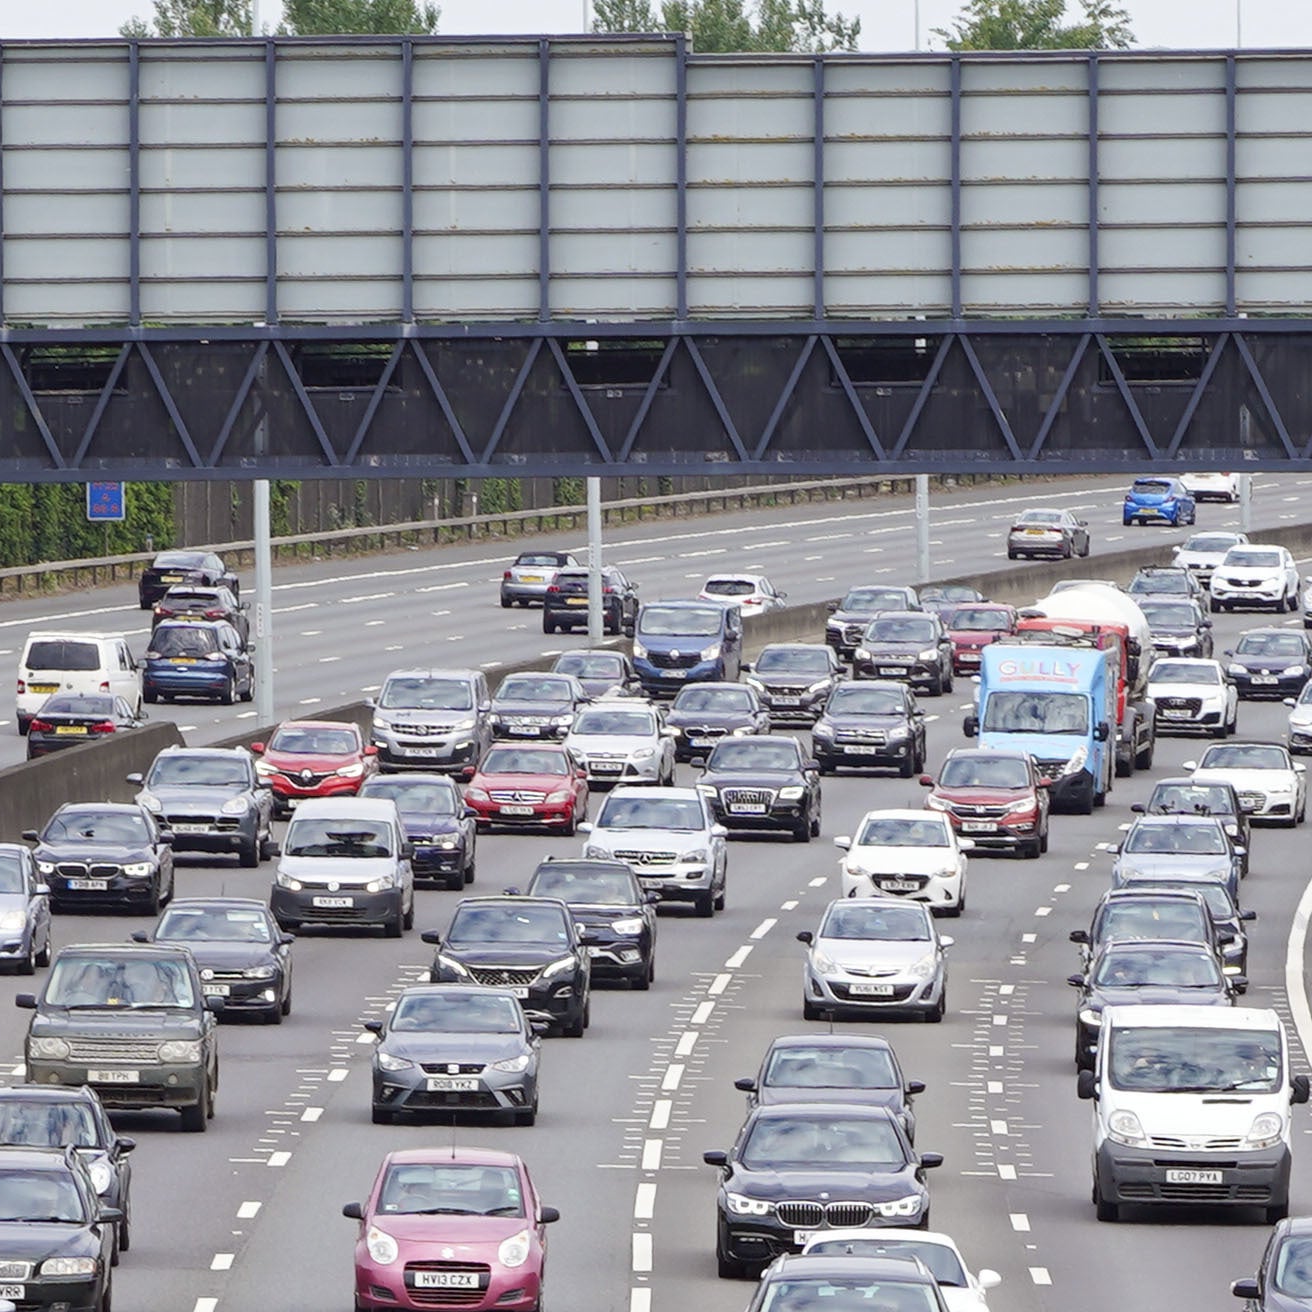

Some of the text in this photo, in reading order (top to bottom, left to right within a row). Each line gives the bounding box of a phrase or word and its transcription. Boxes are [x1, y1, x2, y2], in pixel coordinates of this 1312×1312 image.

[1171, 1172, 1196, 1181] LG07
[423, 1275, 471, 1285] HV13 CZX
